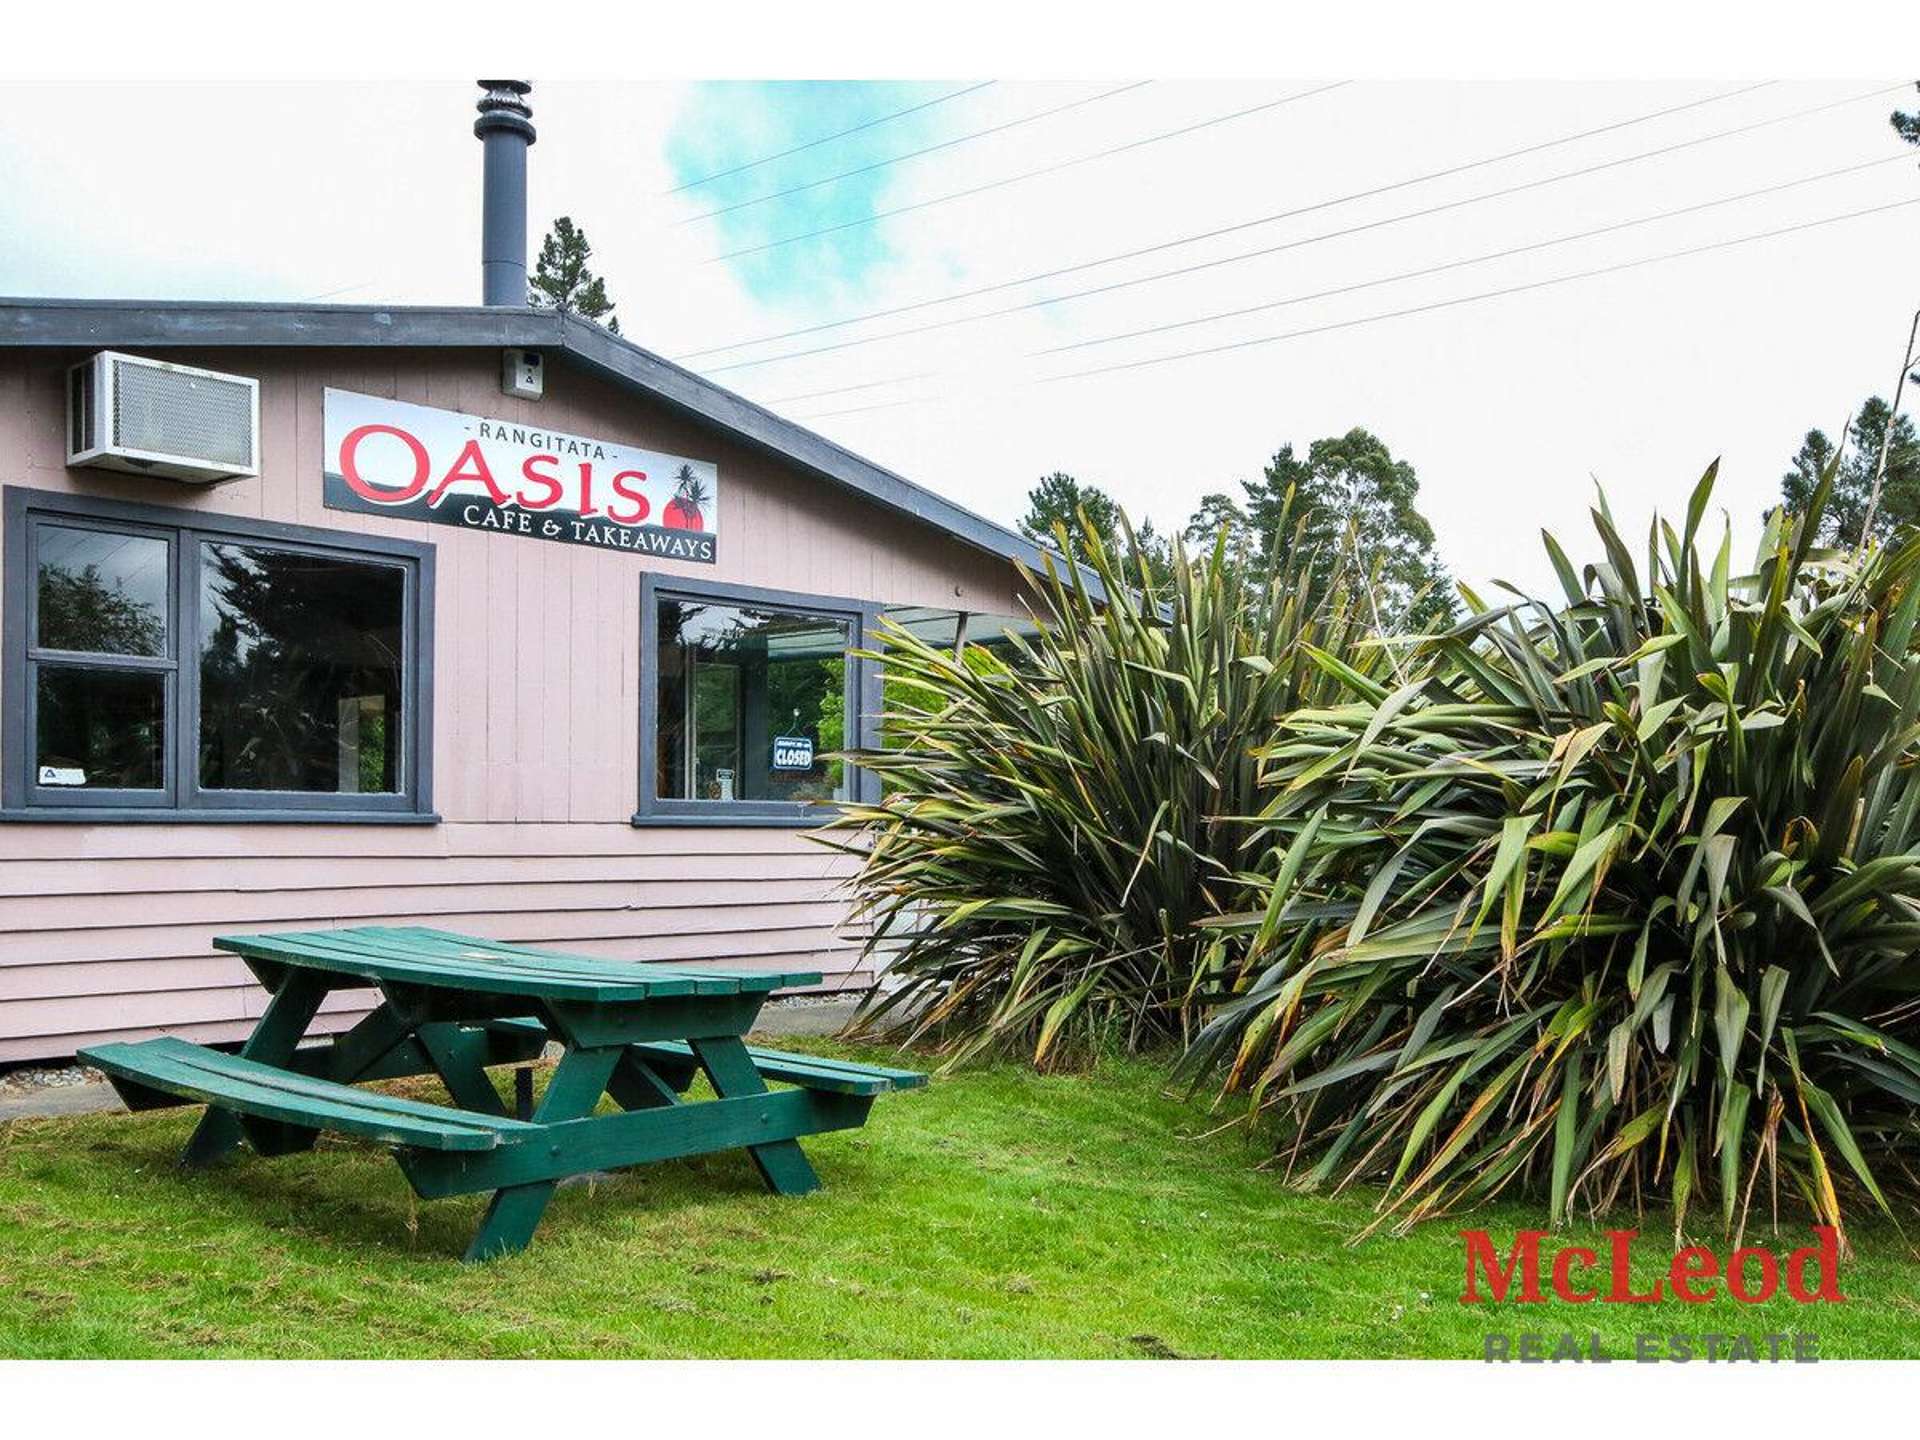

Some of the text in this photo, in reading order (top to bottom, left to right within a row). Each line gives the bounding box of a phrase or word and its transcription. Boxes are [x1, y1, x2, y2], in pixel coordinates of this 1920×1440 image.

[479, 421, 606, 461] RANGITATA
[338, 423, 651, 526] OASIS
[463, 505, 713, 562] CAFE & TAKEAWAYS
[776, 748, 811, 766] CLOSED
